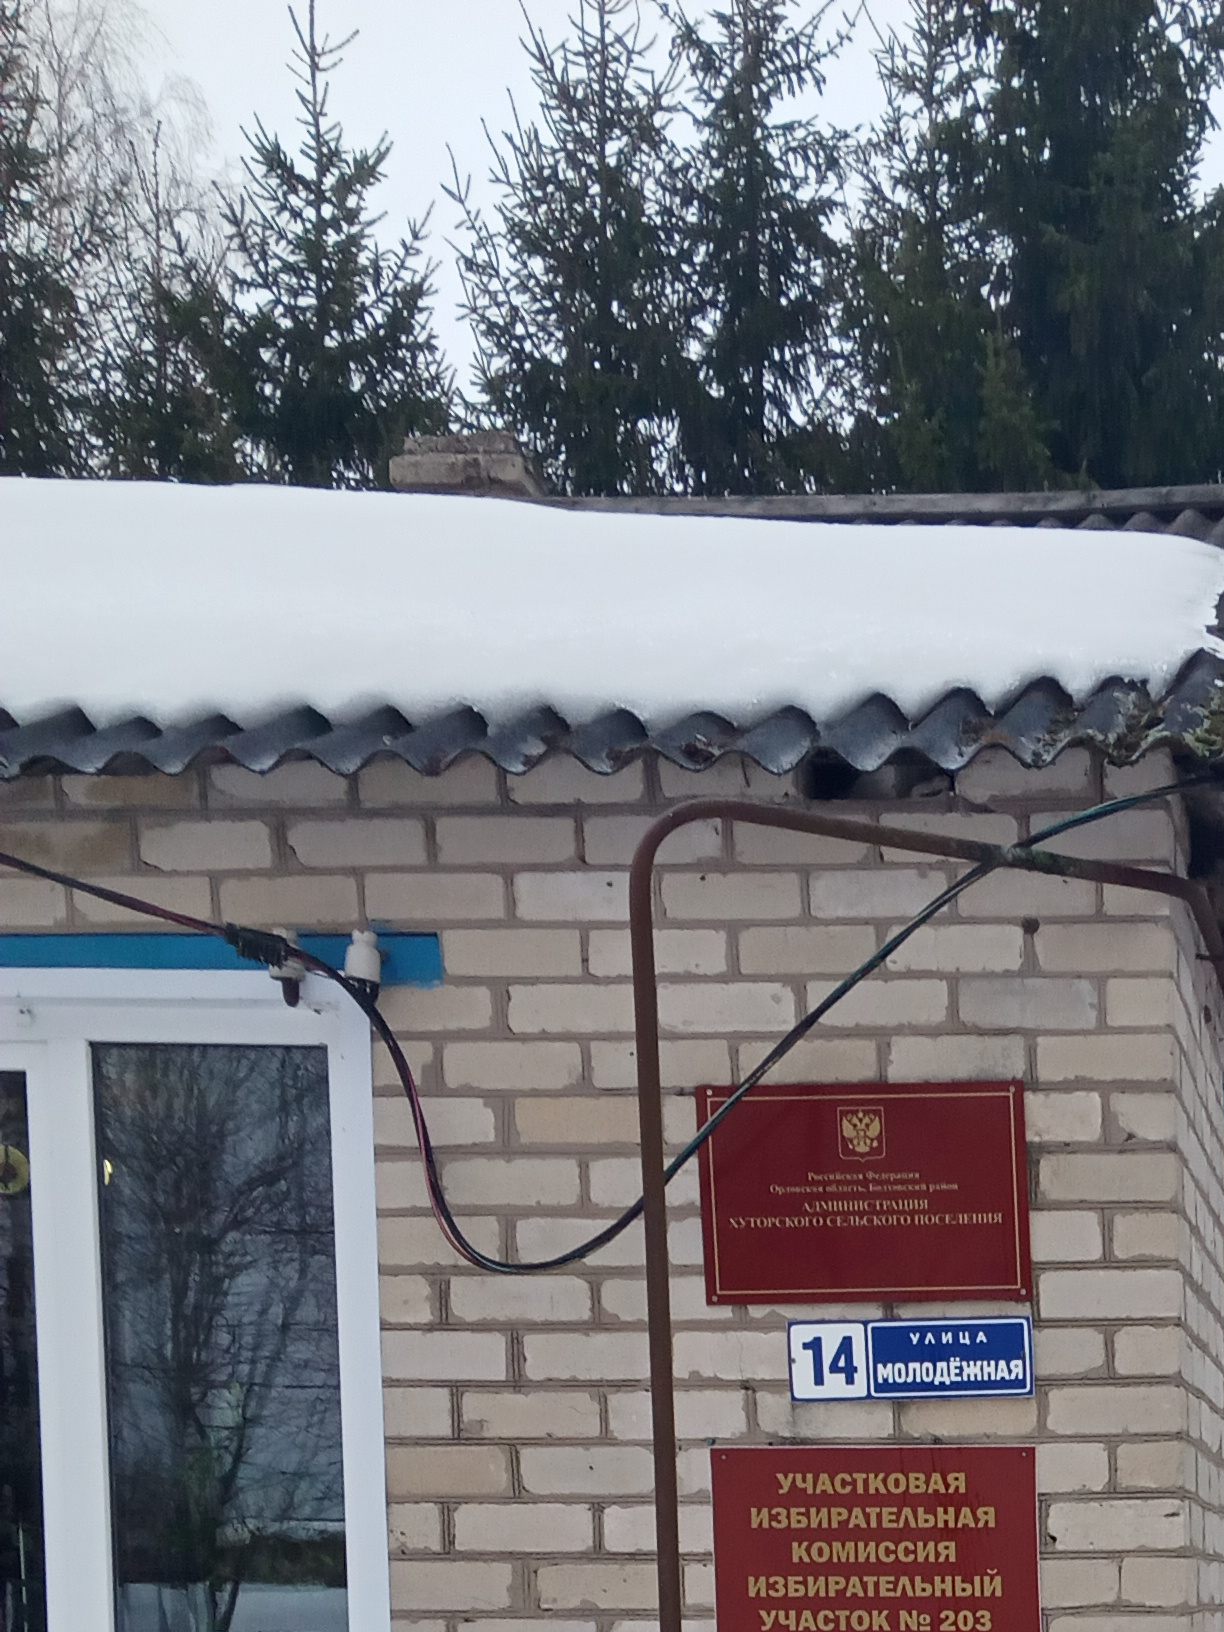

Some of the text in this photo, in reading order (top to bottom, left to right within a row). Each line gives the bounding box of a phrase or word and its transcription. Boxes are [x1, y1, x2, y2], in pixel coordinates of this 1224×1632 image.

[803, 1199, 929, 1213] АДМИНИСТРАЦИЯ
[729, 1212, 1003, 1230] ХУТОРСКОГО СЕЛЬСКОГО ПОСЕЛЕНИЯ
[909, 1331, 988, 1346] УЛИЦА
[801, 1335, 858, 1387] 14
[876, 1357, 1024, 1386] МОЛОДЁЖНАЯ
[775, 1472, 967, 1495] УЧАСТКОВАЯ
[750, 1506, 996, 1529] ИЗБИРАТЕЛЬНАЯ
[791, 1540, 957, 1563] КОМИССИЯ
[748, 1568, 1003, 1598] ИЗБИРАТЕЛЬНЫЙ
[758, 1609, 992, 1632] УЧАСТОК № 203
